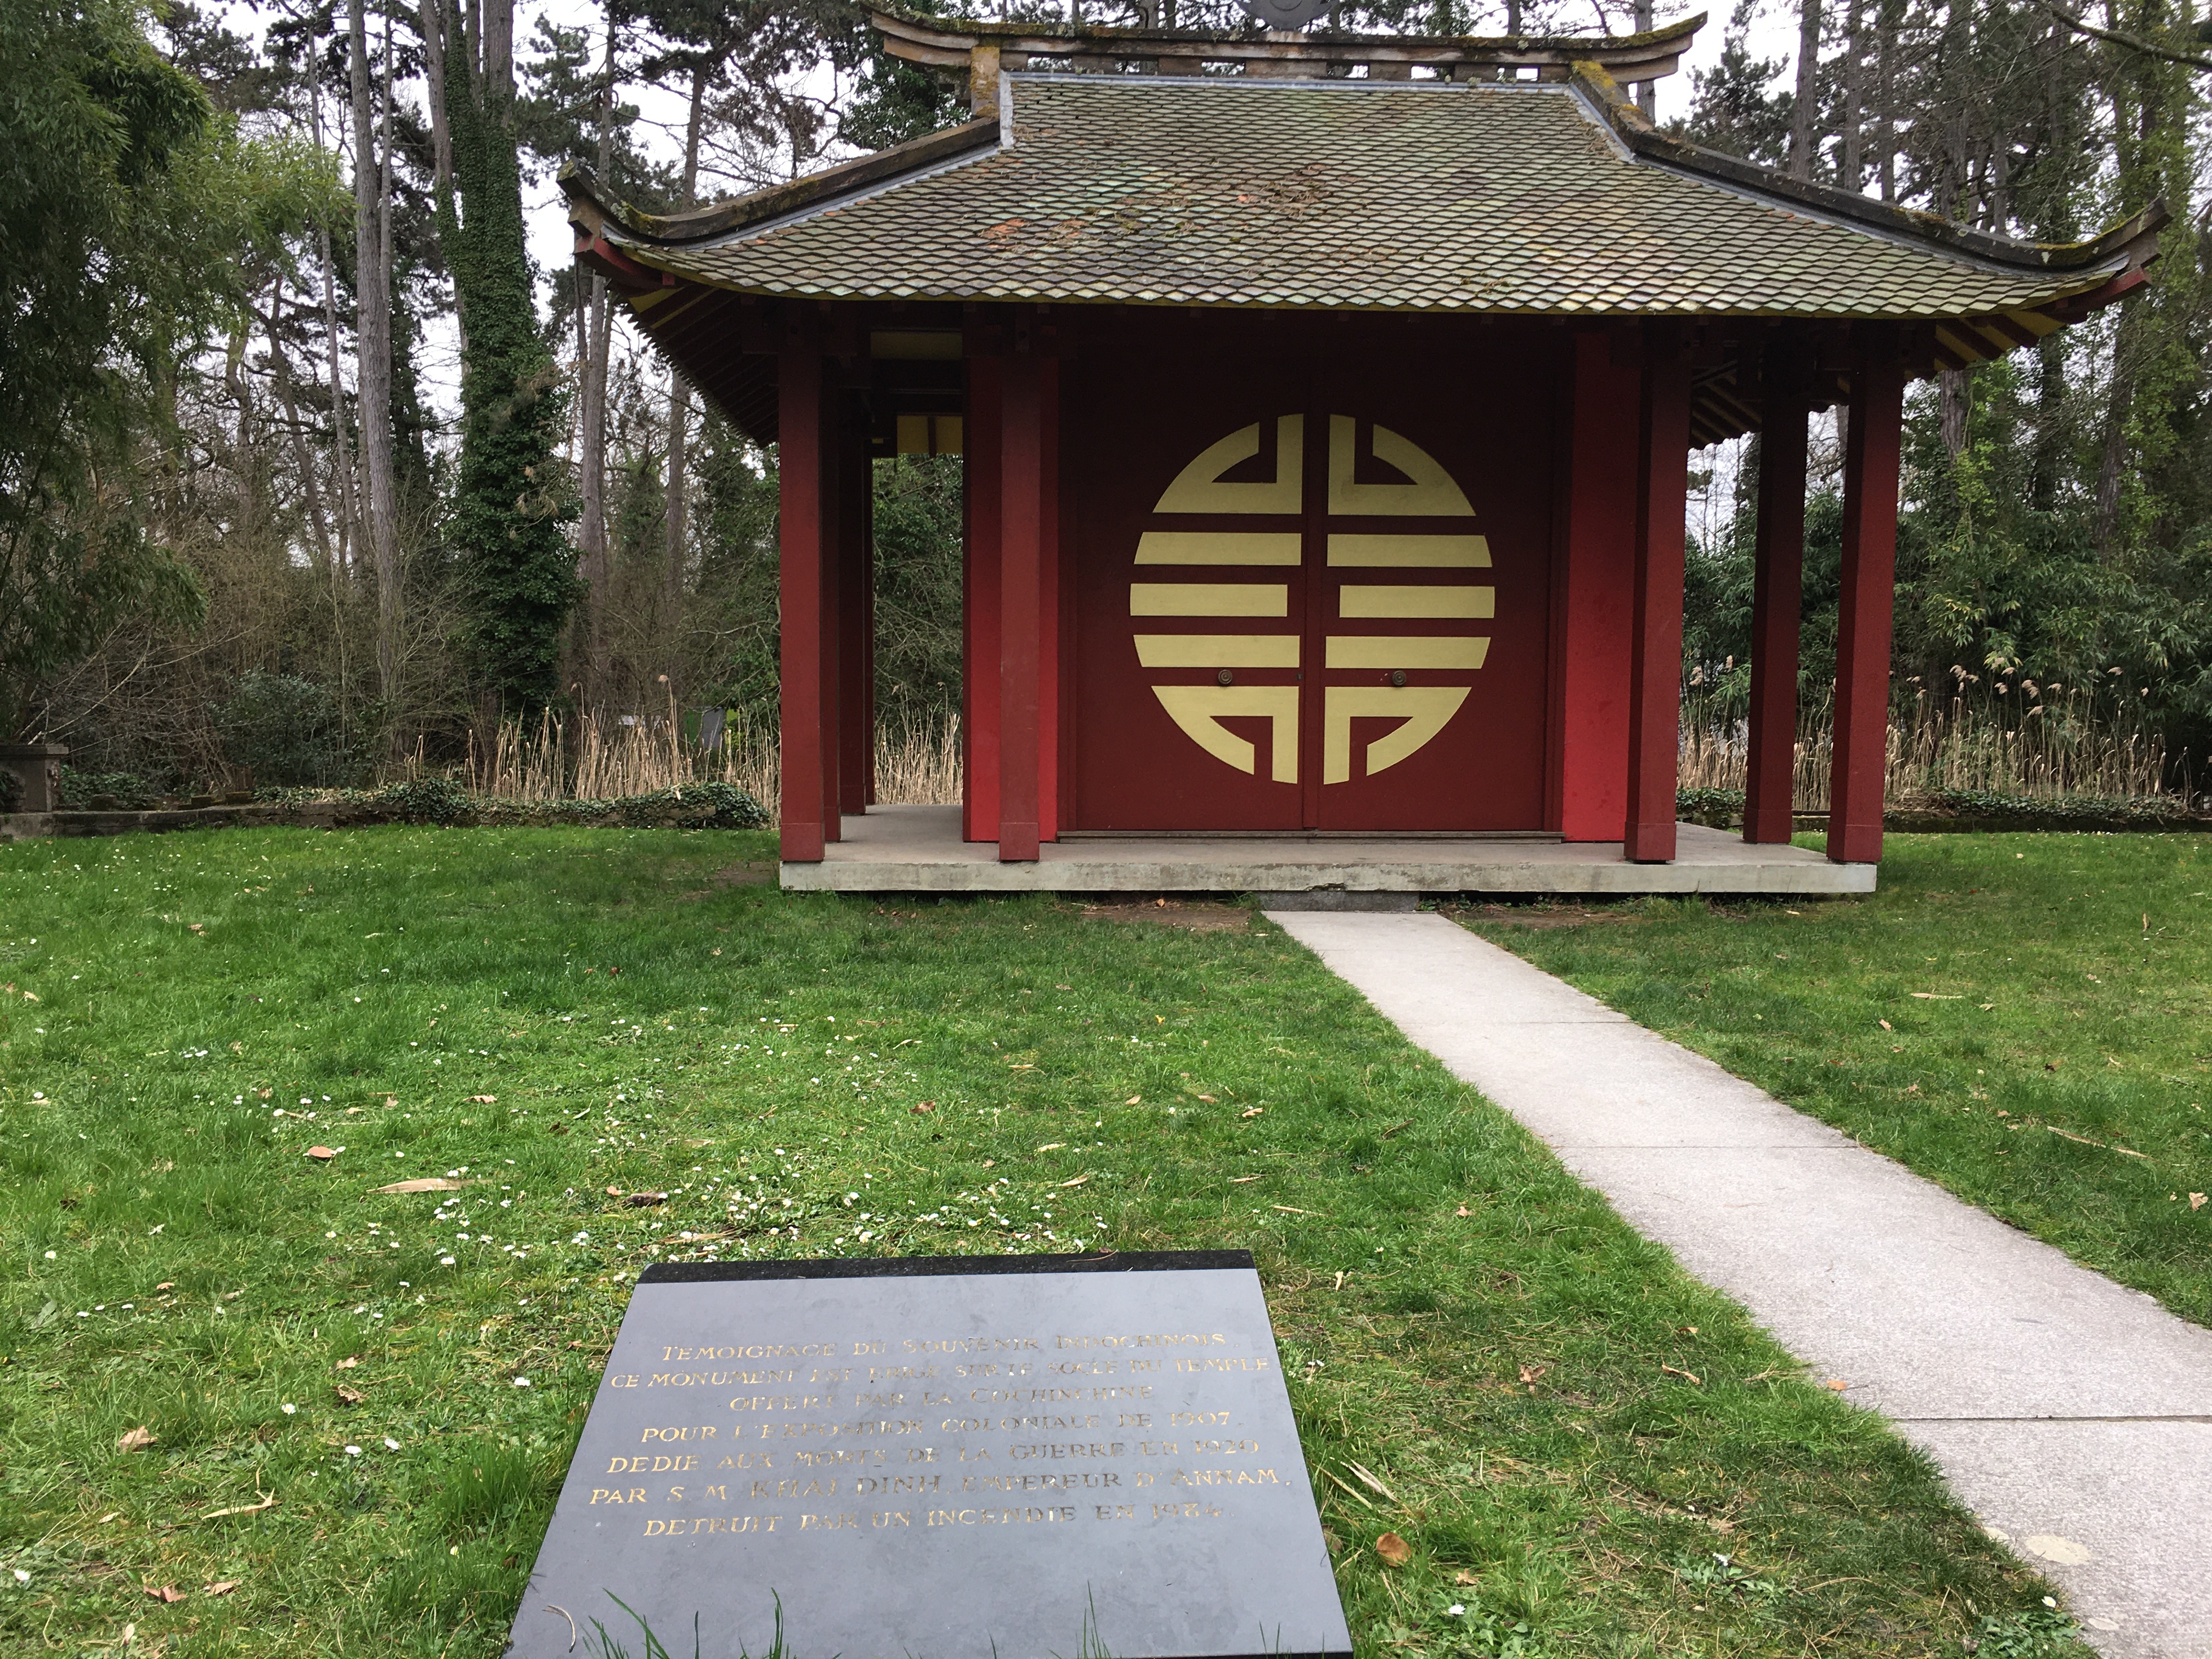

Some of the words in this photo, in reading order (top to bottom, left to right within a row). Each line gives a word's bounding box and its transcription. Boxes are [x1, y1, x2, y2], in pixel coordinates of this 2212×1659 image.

[662, 1343, 836, 1361] TEMOIGNAGE
[853, 1341, 887, 1356] DU
[901, 1336, 1040, 1354] SOUVENIR
[611, 1374, 640, 1387] CE
[647, 1370, 795, 1387] MONUMENT
[809, 1368, 854, 1382] EST
[868, 1365, 942, 1380] ERIGE
[1047, 1361, 1118, 1376] SOCLE
[1130, 1360, 1162, 1373] DU
[1176, 1357, 1269, 1372] TEMPLE
[730, 1395, 836, 1412] OFFERT
[855, 1391, 906, 1408] PAR
[922, 1391, 952, 1406] LA
[970, 1386, 1153, 1404] COCHINCHINE
[641, 1426, 717, 1443] POUR
[733, 1419, 924, 1440] L'EXPOSITION
[941, 1414, 1100, 1432] COLONIALE
[1118, 1414, 1152, 1427] DE
[607, 1455, 701, 1473] DEDIE
[716, 1452, 777, 1470] AUX
[794, 1449, 887, 1466] MORTS
[907, 1447, 941, 1464] DE
[960, 1446, 991, 1462] LA
[1009, 1442, 1124, 1460] GUERRE
[1141, 1441, 1178, 1457] EN
[1194, 1439, 1260, 1455] 1920
[590, 1487, 648, 1505] PAR
[749, 1478, 837, 1498] KHAI
[962, 1472, 1122, 1492] EMPEREUR
[643, 1516, 783, 1536] DETRUIT
[799, 1514, 857, 1531] PAR
[872, 1511, 910, 1527] UN
[928, 1505, 1075, 1526] INCENDIE
[1094, 1505, 1133, 1520] EN
